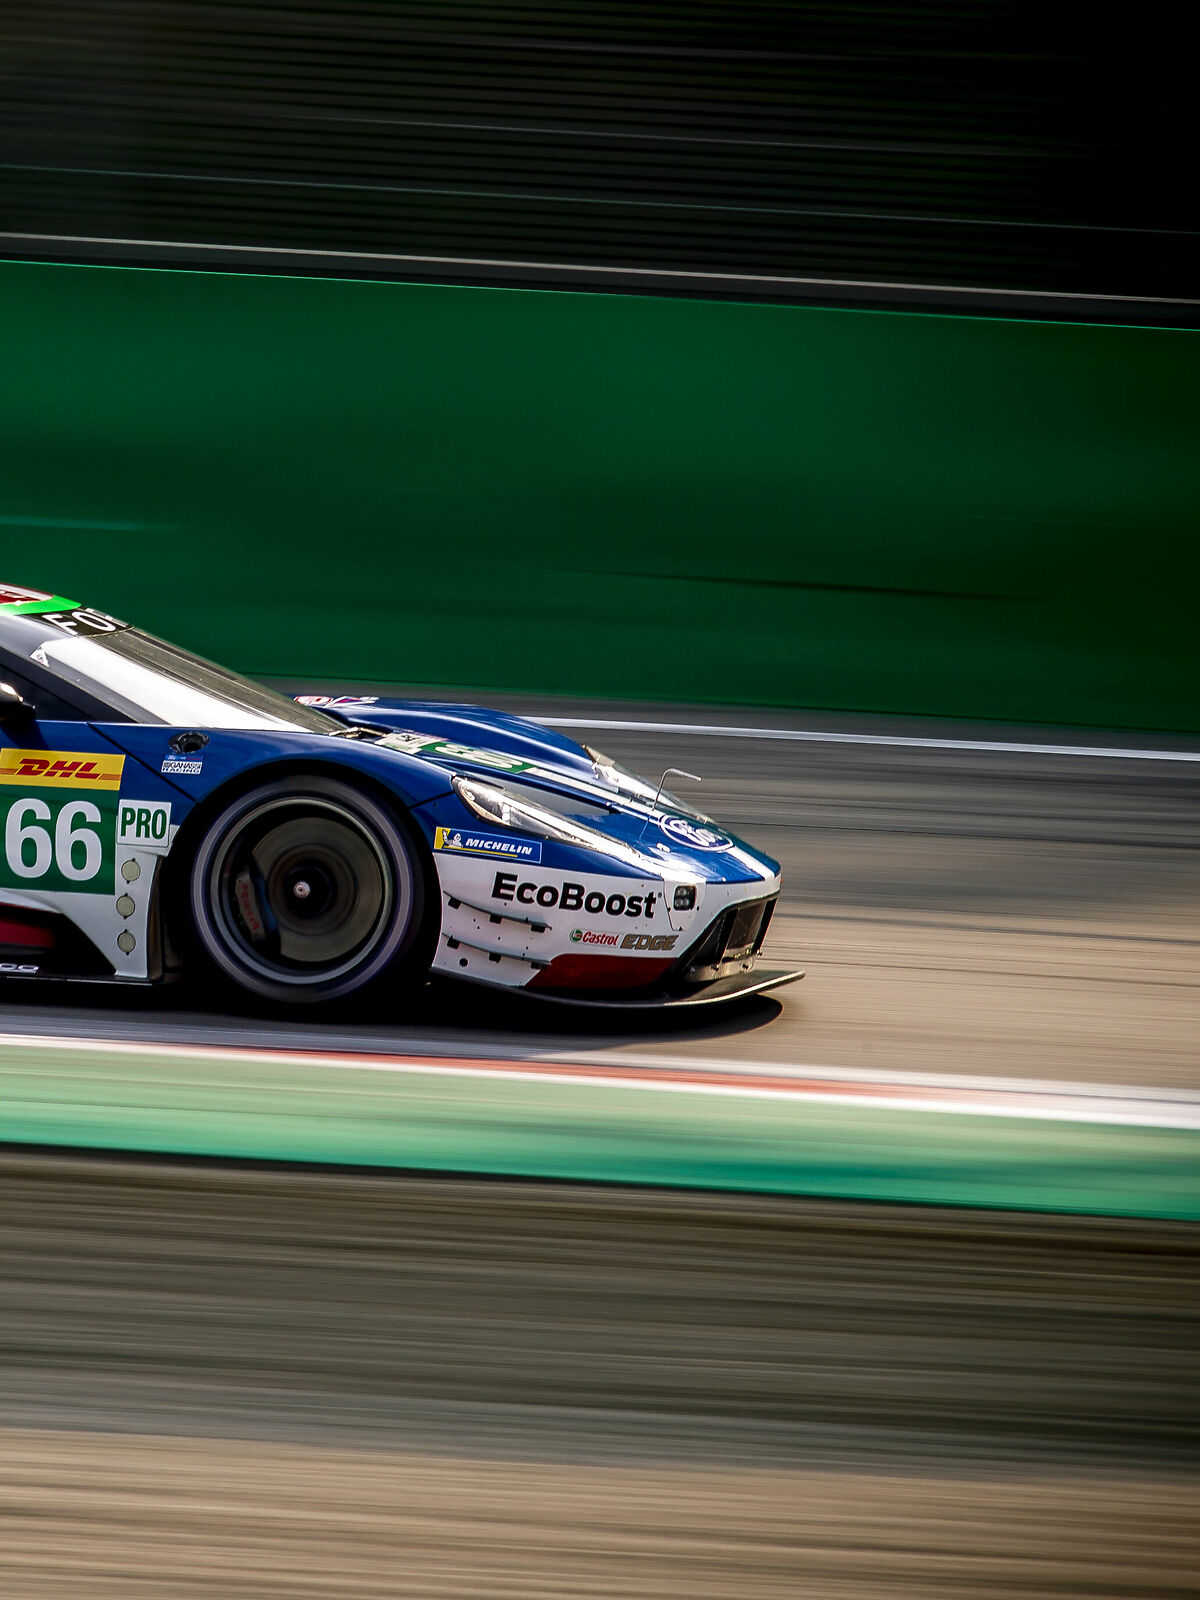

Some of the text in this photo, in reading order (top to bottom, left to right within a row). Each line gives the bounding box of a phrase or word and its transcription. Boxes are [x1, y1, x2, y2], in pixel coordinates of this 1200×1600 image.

[15, 758, 101, 780] DHL
[120, 806, 167, 840] PRO
[5, 798, 102, 881] 66
[465, 838, 532, 855] MICHELIN
[491, 871, 657, 918] EcoBoost
[582, 931, 679, 951] Castrol EDGE
